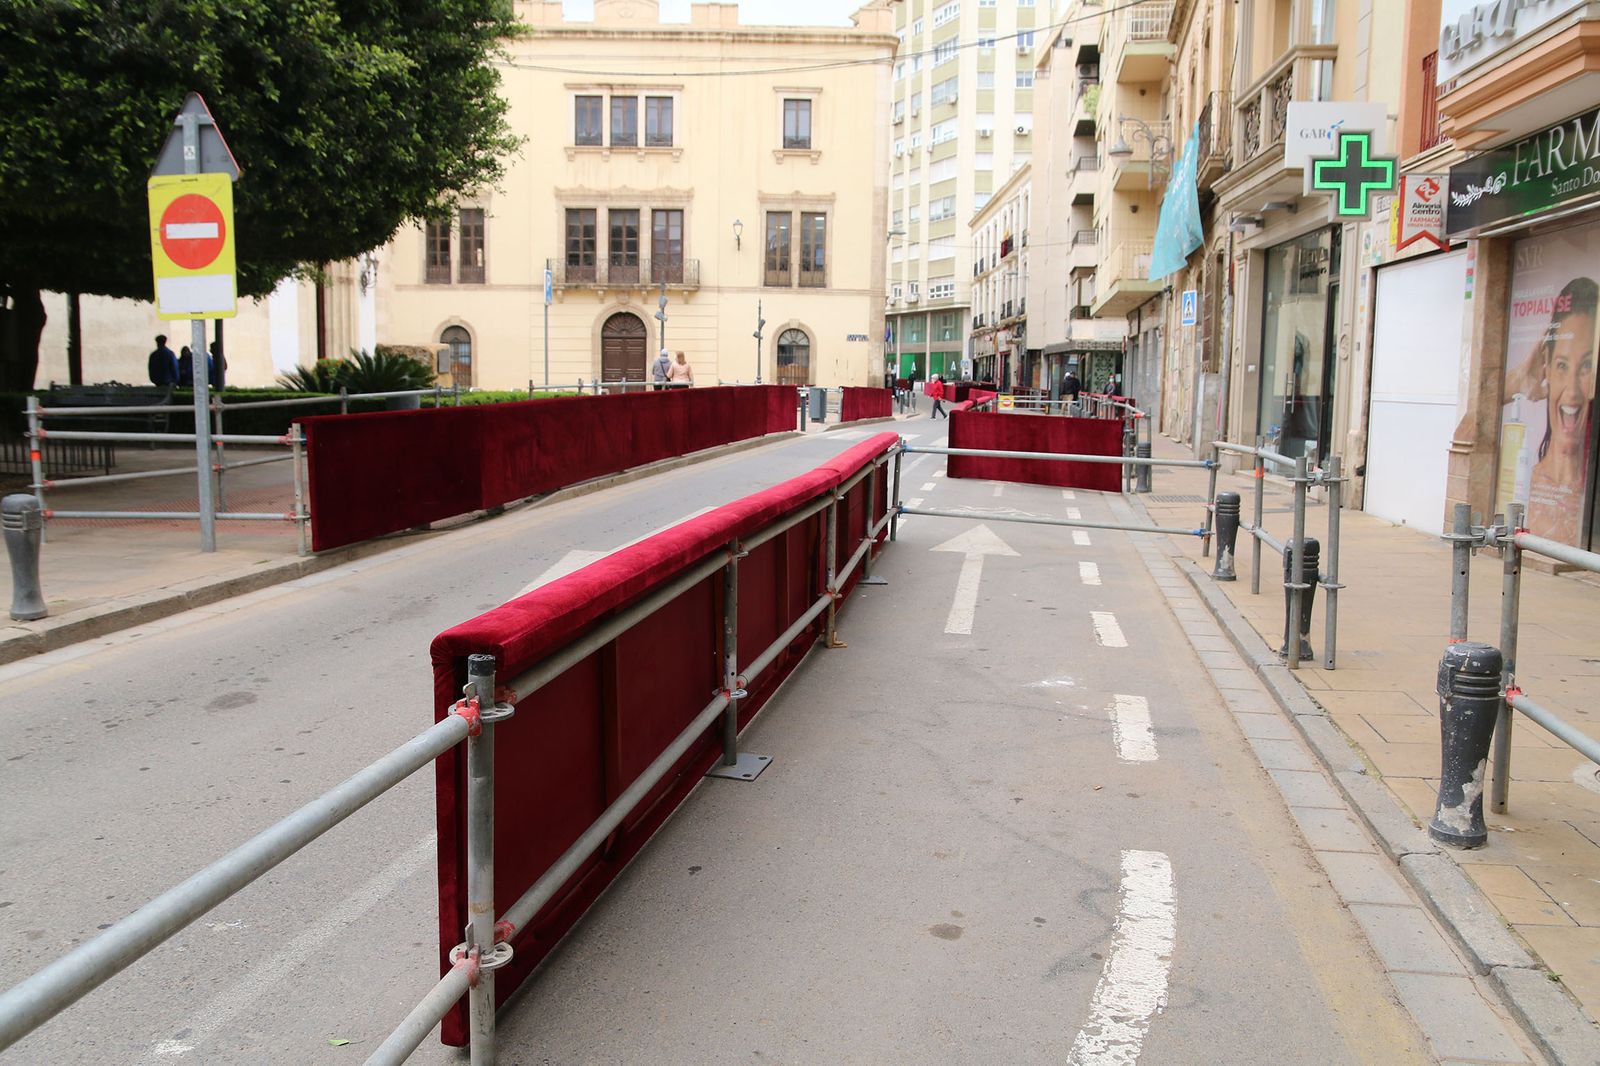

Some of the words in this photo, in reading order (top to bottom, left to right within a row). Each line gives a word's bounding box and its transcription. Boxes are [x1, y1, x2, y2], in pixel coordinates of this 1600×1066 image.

[1511, 108, 1600, 186] FARM
[1551, 177, 1580, 197] Santo
[1513, 293, 1572, 319] TOPIALYSE
